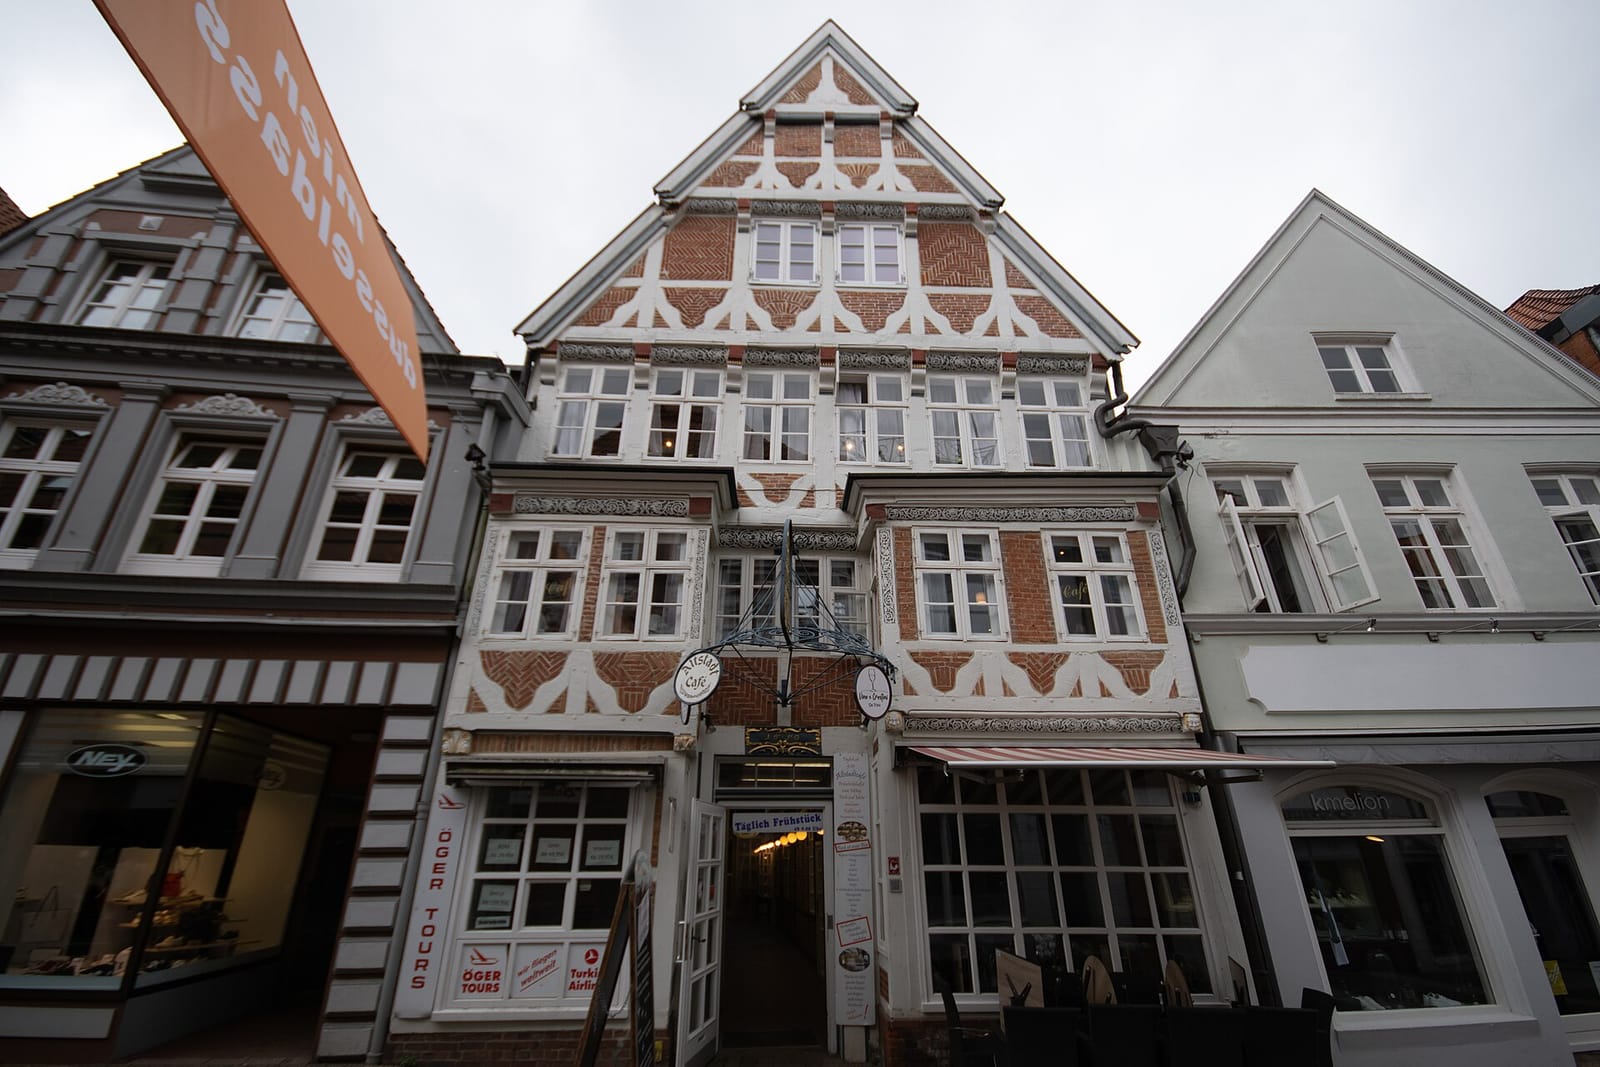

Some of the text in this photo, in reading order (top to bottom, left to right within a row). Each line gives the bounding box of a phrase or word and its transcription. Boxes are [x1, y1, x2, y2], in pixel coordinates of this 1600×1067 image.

[682, 654, 719, 676] Altstadt
[686, 675, 707, 690] Café
[1309, 791, 1390, 812] kmelion
[735, 814, 822, 833] Täglich Frühstück
[429, 827, 452, 890] ÖGER
[410, 908, 439, 989] TOURS
[462, 968, 501, 982] ÖGER
[520, 959, 557, 987] weltweit
[570, 967, 599, 978] Turki
[461, 983, 500, 994] TOURS
[568, 981, 597, 991] Airlin
